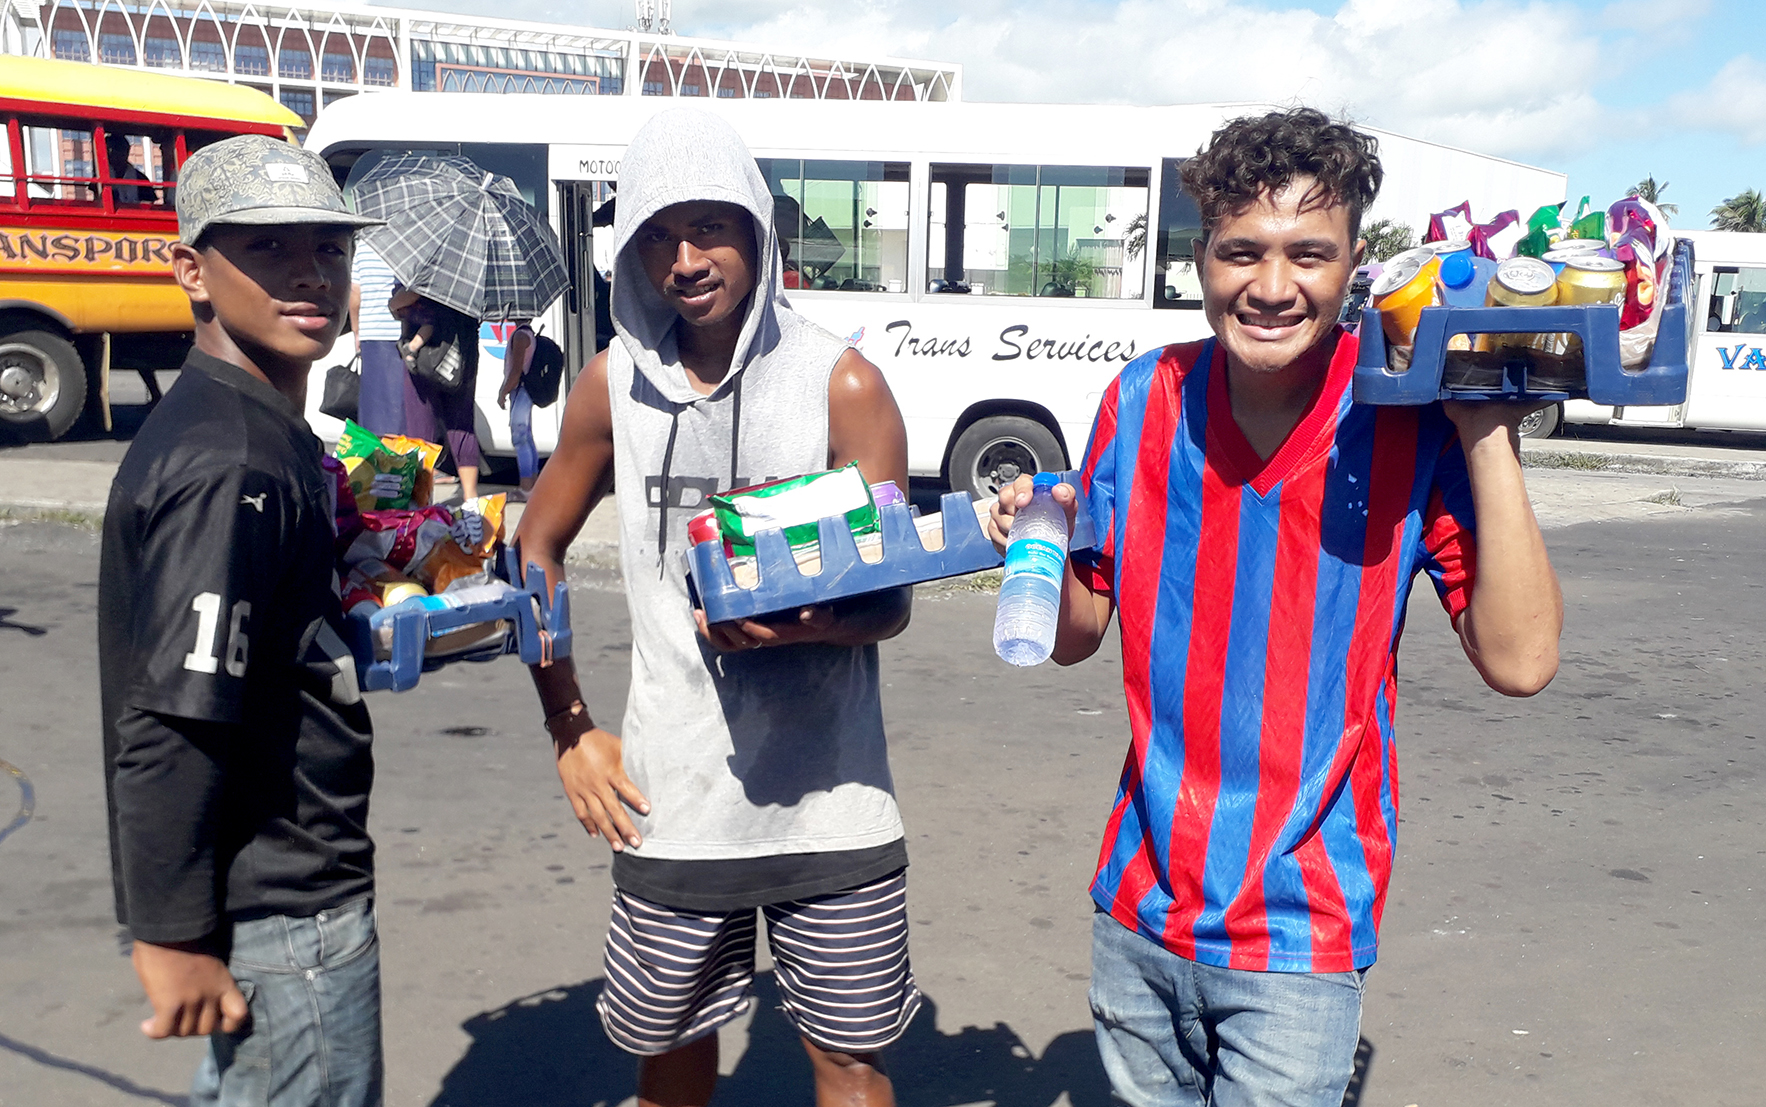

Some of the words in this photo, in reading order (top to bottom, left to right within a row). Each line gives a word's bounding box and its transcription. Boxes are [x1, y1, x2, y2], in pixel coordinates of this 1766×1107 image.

[0, 231, 181, 264] ANSPOR
[885, 319, 972, 357] Trans
[991, 324, 1138, 363] Services
[1715, 343, 1766, 371] VA
[183, 591, 252, 678] 16
